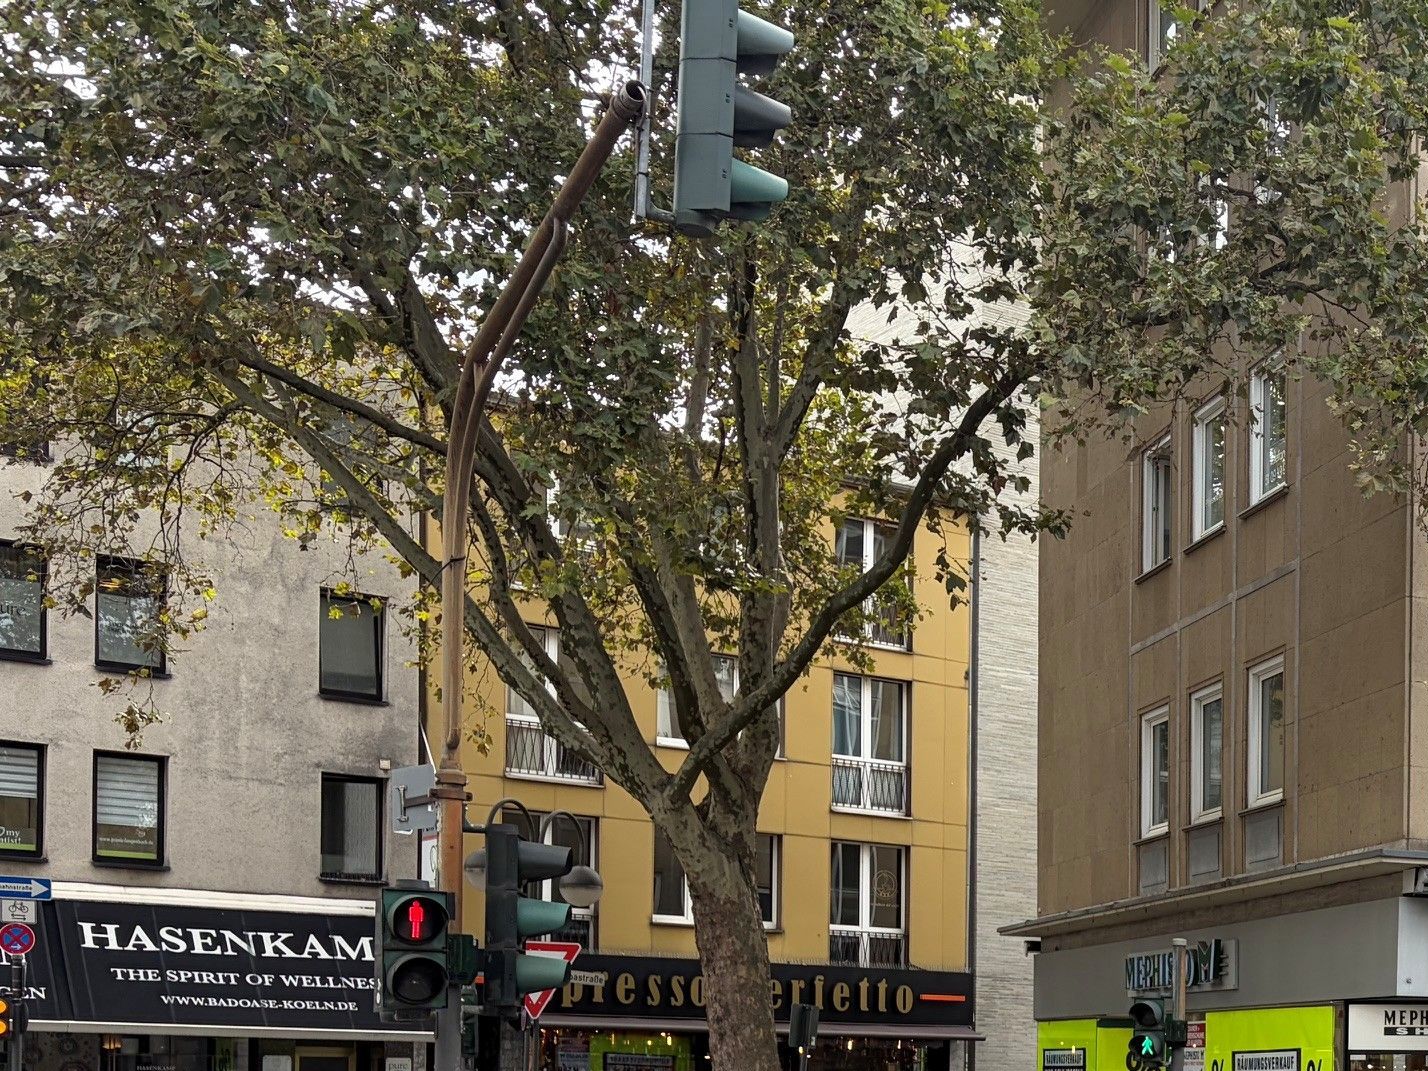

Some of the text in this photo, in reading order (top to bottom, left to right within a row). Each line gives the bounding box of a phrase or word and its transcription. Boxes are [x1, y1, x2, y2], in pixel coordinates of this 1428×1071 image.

[0, 883, 33, 891] ahnstraße
[77, 921, 376, 961] HASENKAM
[110, 967, 375, 990] THE SPIRIT OF WELLNES
[160, 994, 359, 1011] WWW.BADOASE-KOELN.DE
[769, 974, 914, 1014] erfetto
[1236, 1055, 1294, 1070] RÄUMUNGSVERKAUF
